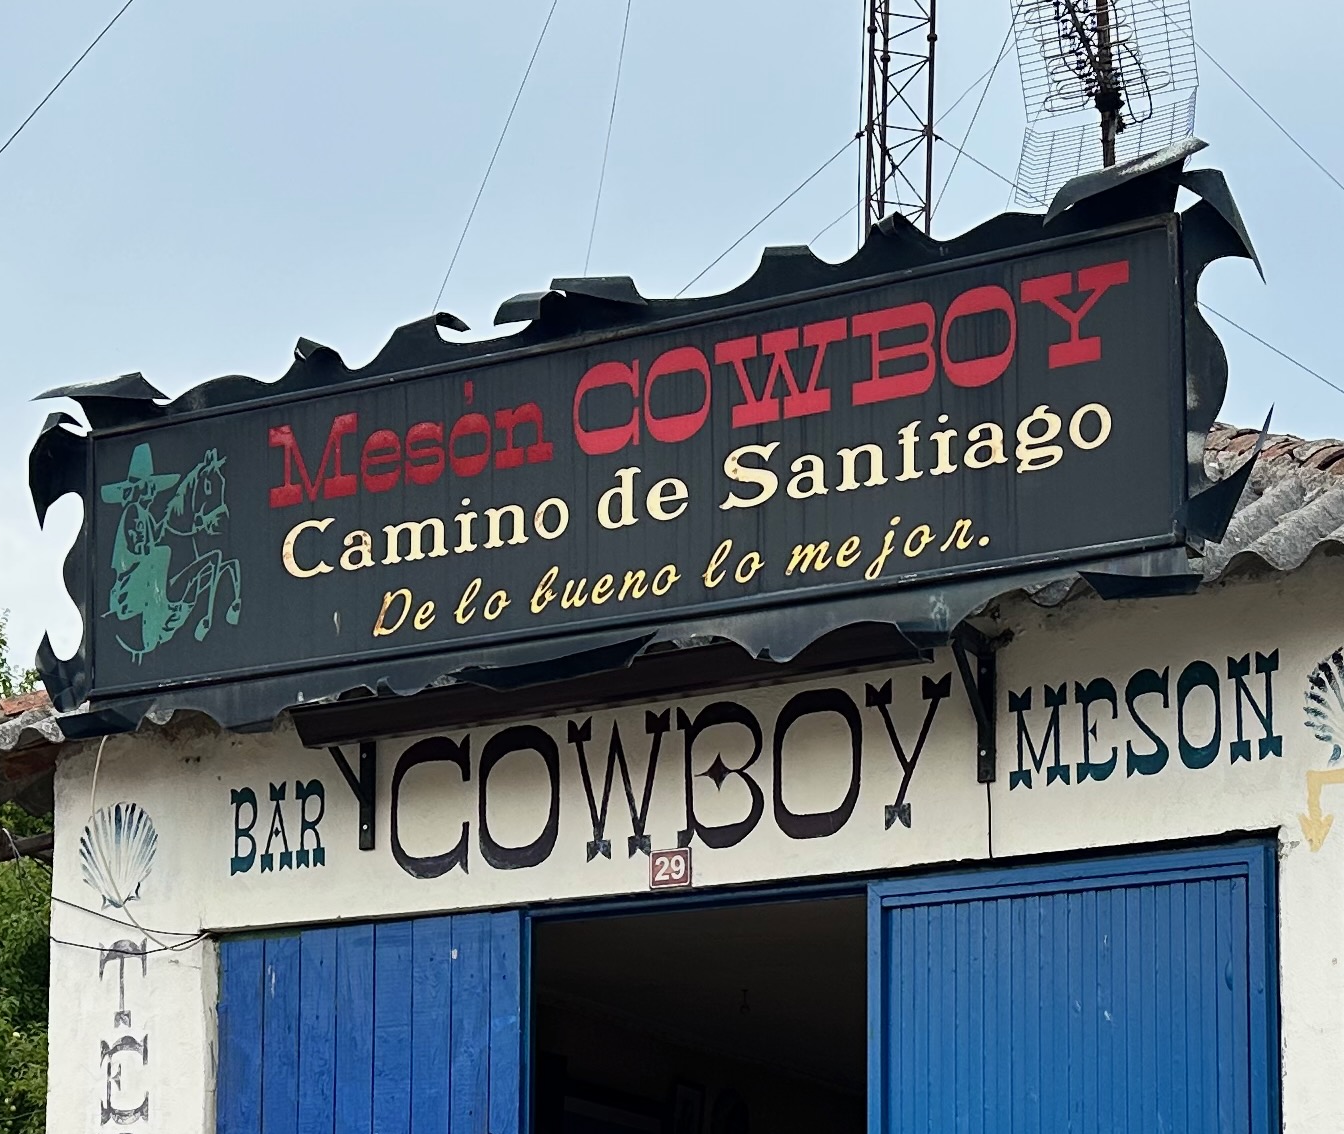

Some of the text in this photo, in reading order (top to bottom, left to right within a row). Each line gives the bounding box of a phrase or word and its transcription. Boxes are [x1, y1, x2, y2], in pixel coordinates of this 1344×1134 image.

[268, 260, 1129, 508] Mesón COWBOY
[281, 402, 1113, 580] Camino de Santiago
[373, 515, 992, 638] De lo bueno lo mejor.
[230, 647, 1283, 879] BAR COWBOY MESON
[654, 854, 686, 882] 29
